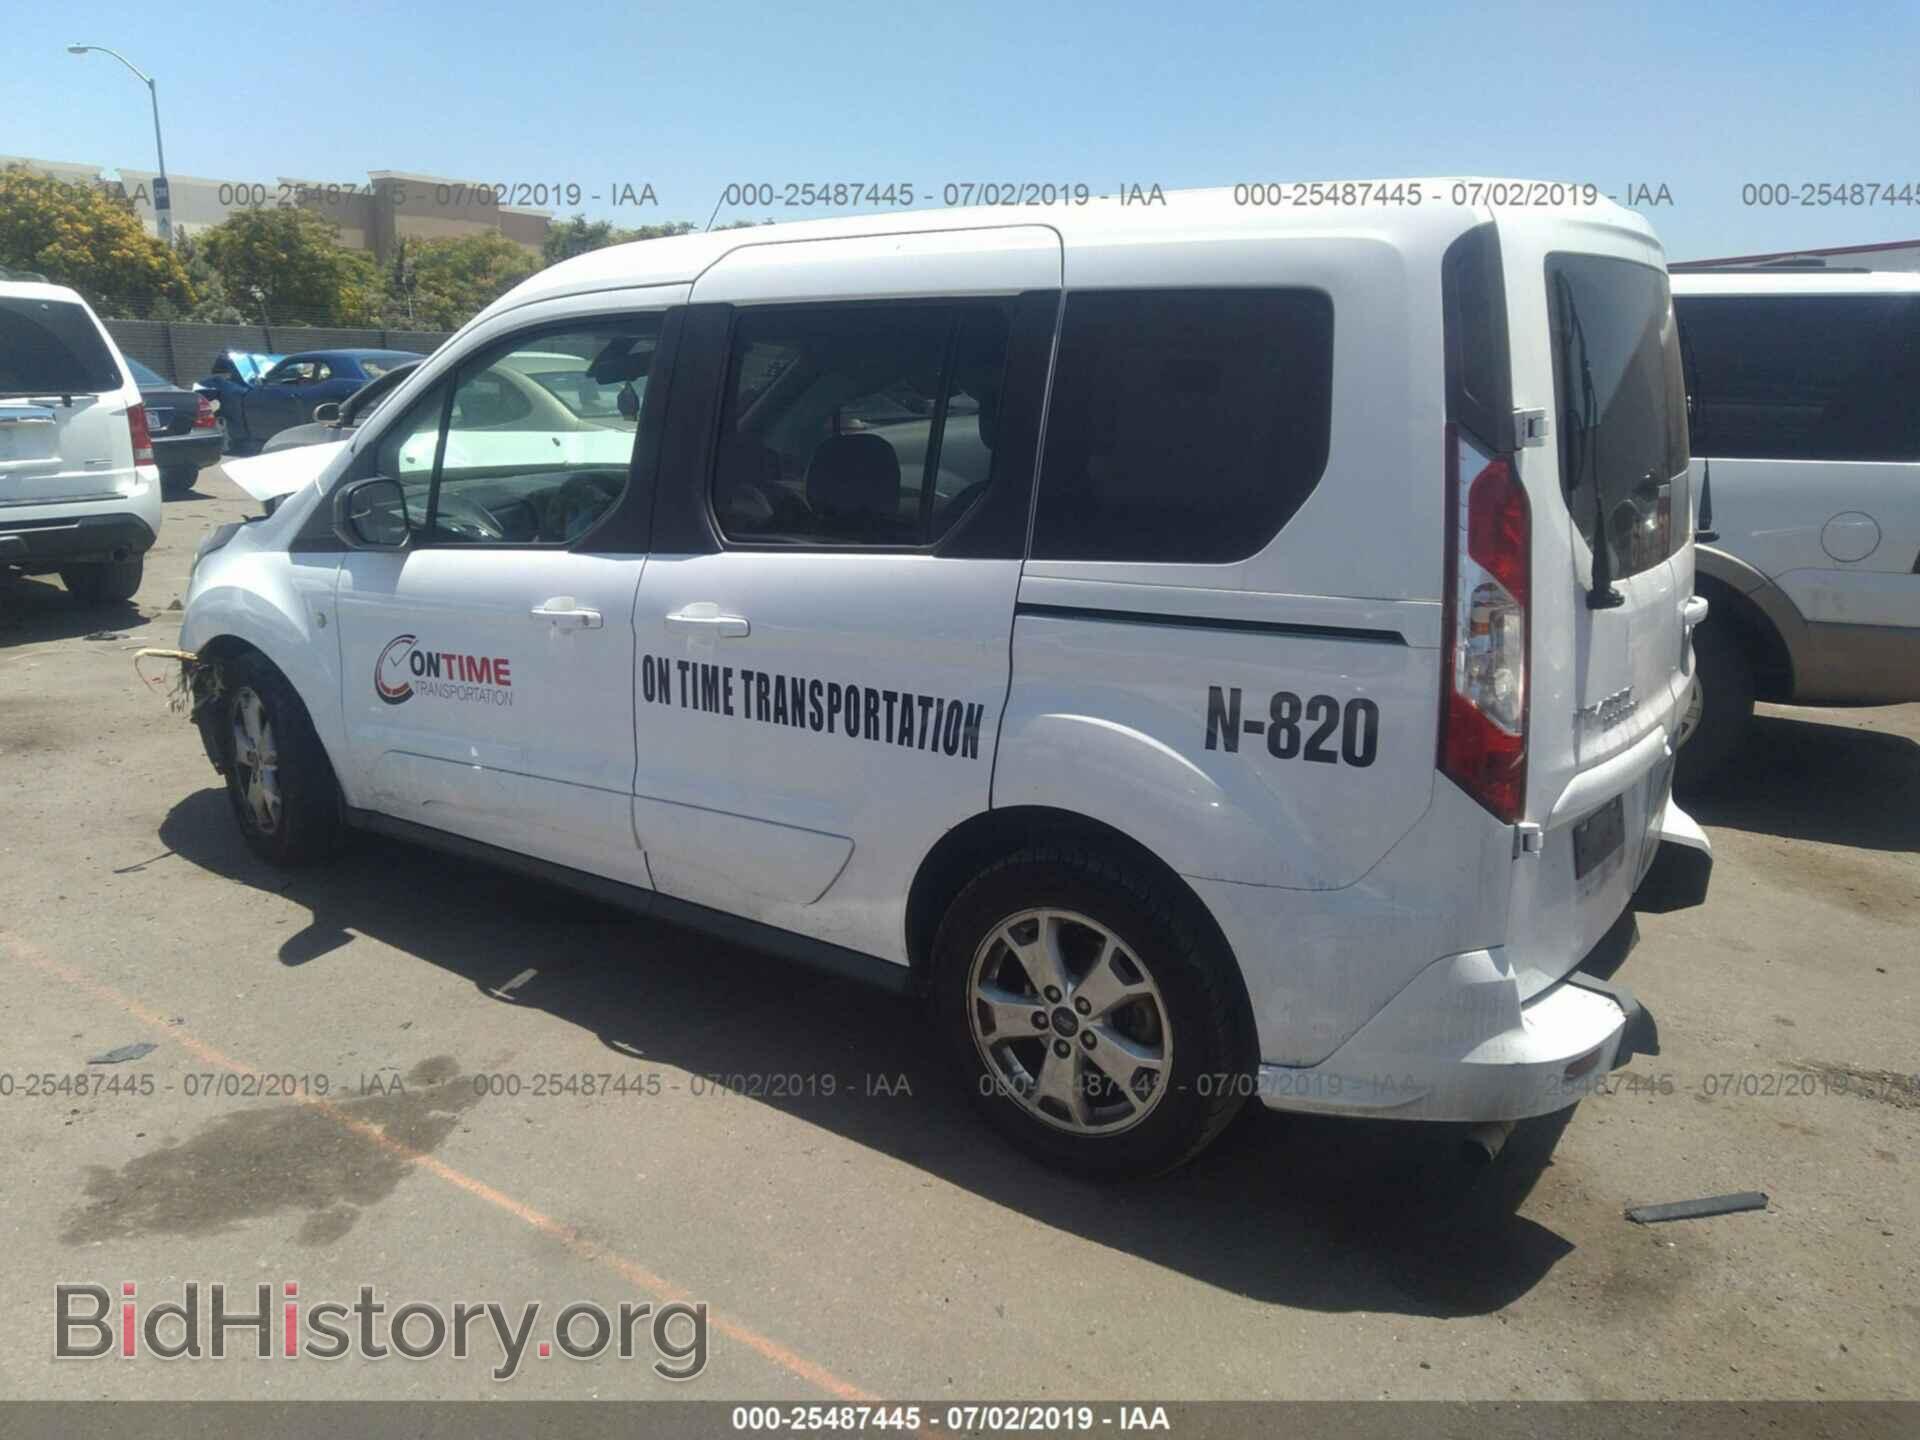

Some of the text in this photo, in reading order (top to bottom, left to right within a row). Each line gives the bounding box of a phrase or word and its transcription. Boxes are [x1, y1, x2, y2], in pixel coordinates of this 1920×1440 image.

[415, 680, 513, 706] TRANSPORTATION
[642, 653, 984, 760] ON TIME TRANSPORTATION
[1205, 685, 1380, 768] N-820
